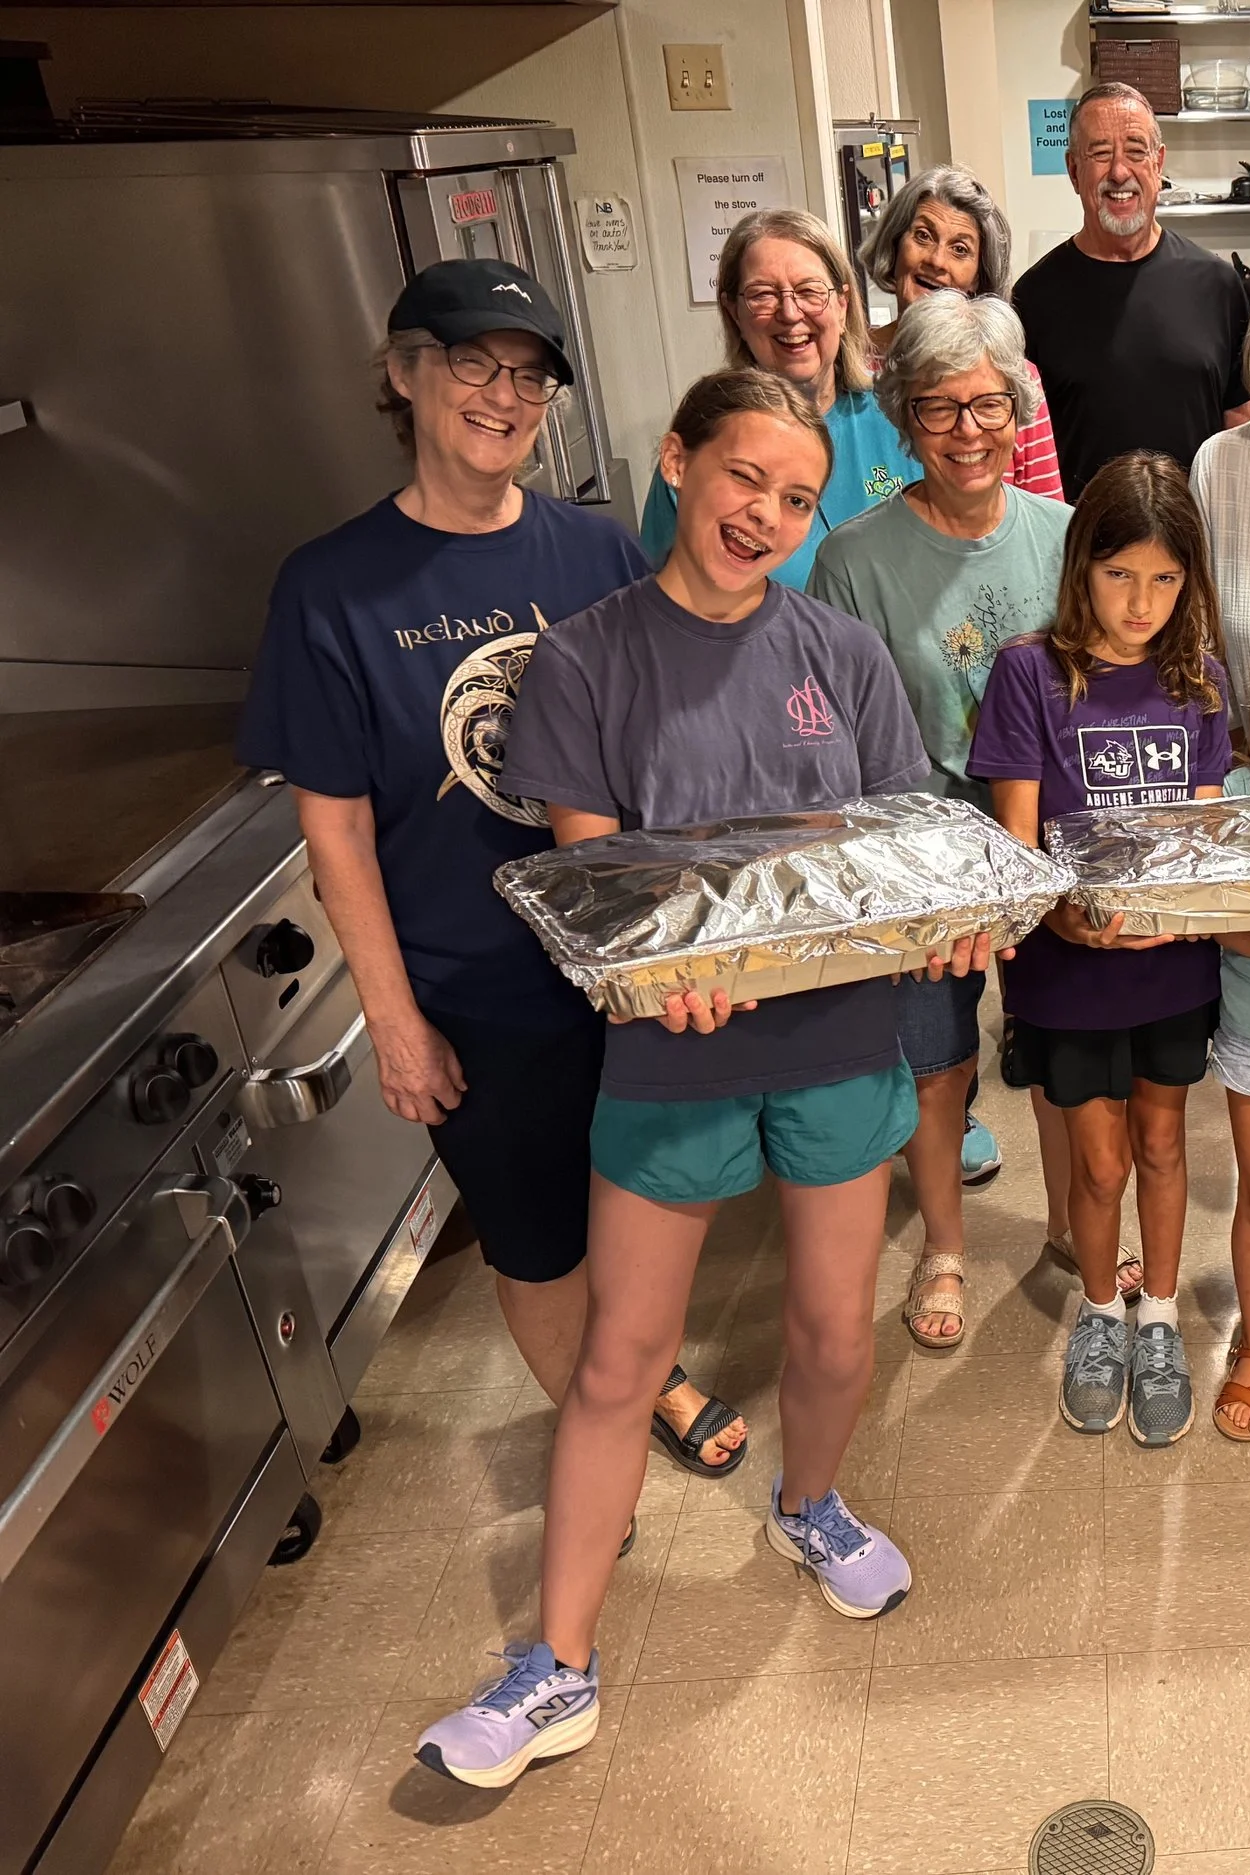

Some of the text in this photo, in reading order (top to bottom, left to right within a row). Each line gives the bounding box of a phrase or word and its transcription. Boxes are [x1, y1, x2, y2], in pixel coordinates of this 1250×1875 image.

[1043, 108, 1067, 119] Lost
[1046, 123, 1066, 133] and
[1036, 136, 1069, 147] Found
[697, 172, 765, 184] Please turn off
[714, 200, 757, 209] the stove
[711, 226, 733, 235] burn
[393, 608, 514, 651] IRELAND
[1092, 754, 1129, 776] ACU
[1086, 792, 1134, 807] ABILENE
[107, 1332, 156, 1404] WOLF
